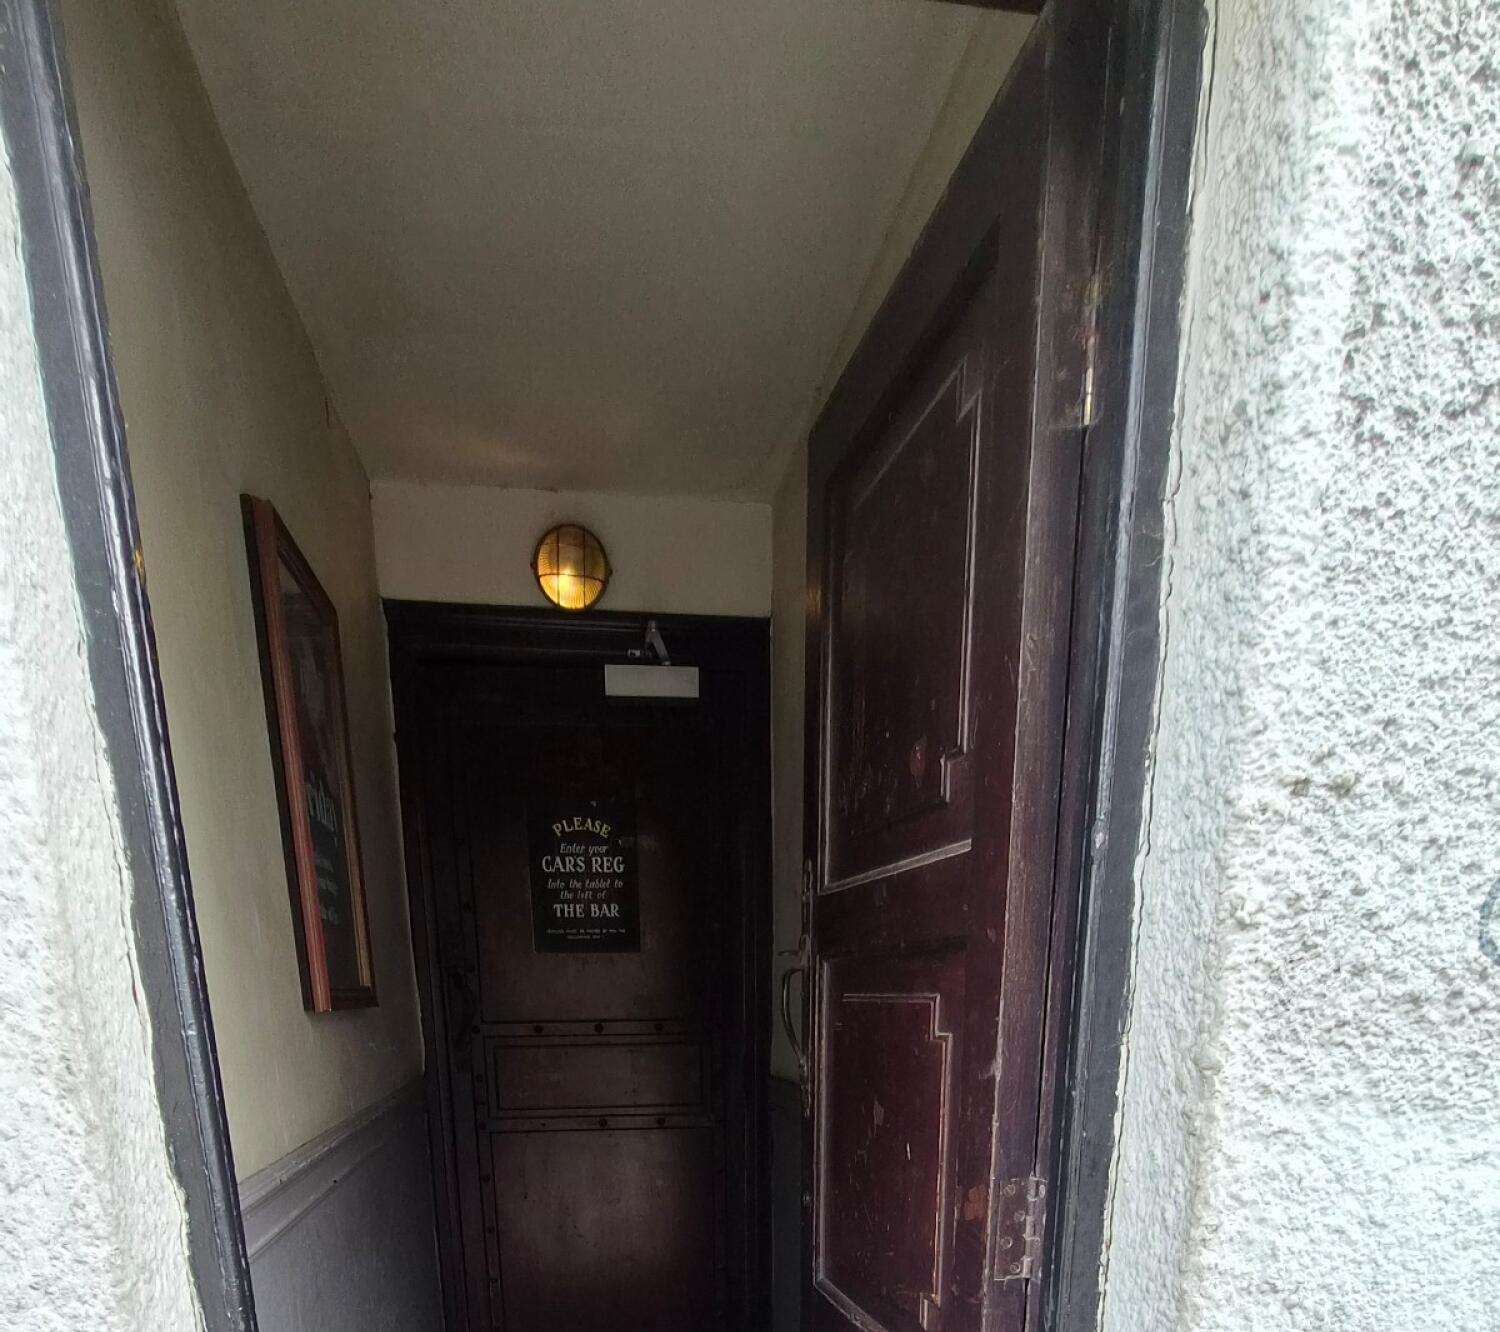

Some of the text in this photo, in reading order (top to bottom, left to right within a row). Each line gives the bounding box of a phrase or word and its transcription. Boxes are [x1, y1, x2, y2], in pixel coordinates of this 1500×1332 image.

[552, 817, 611, 838] PLEASE
[560, 843, 585, 854] Enter
[591, 855, 625, 873] REG
[569, 878, 582, 889] the
[585, 878, 611, 889] tablet
[614, 878, 624, 889] to
[560, 890, 608, 900] the left of
[553, 903, 620, 918] THE BAR
